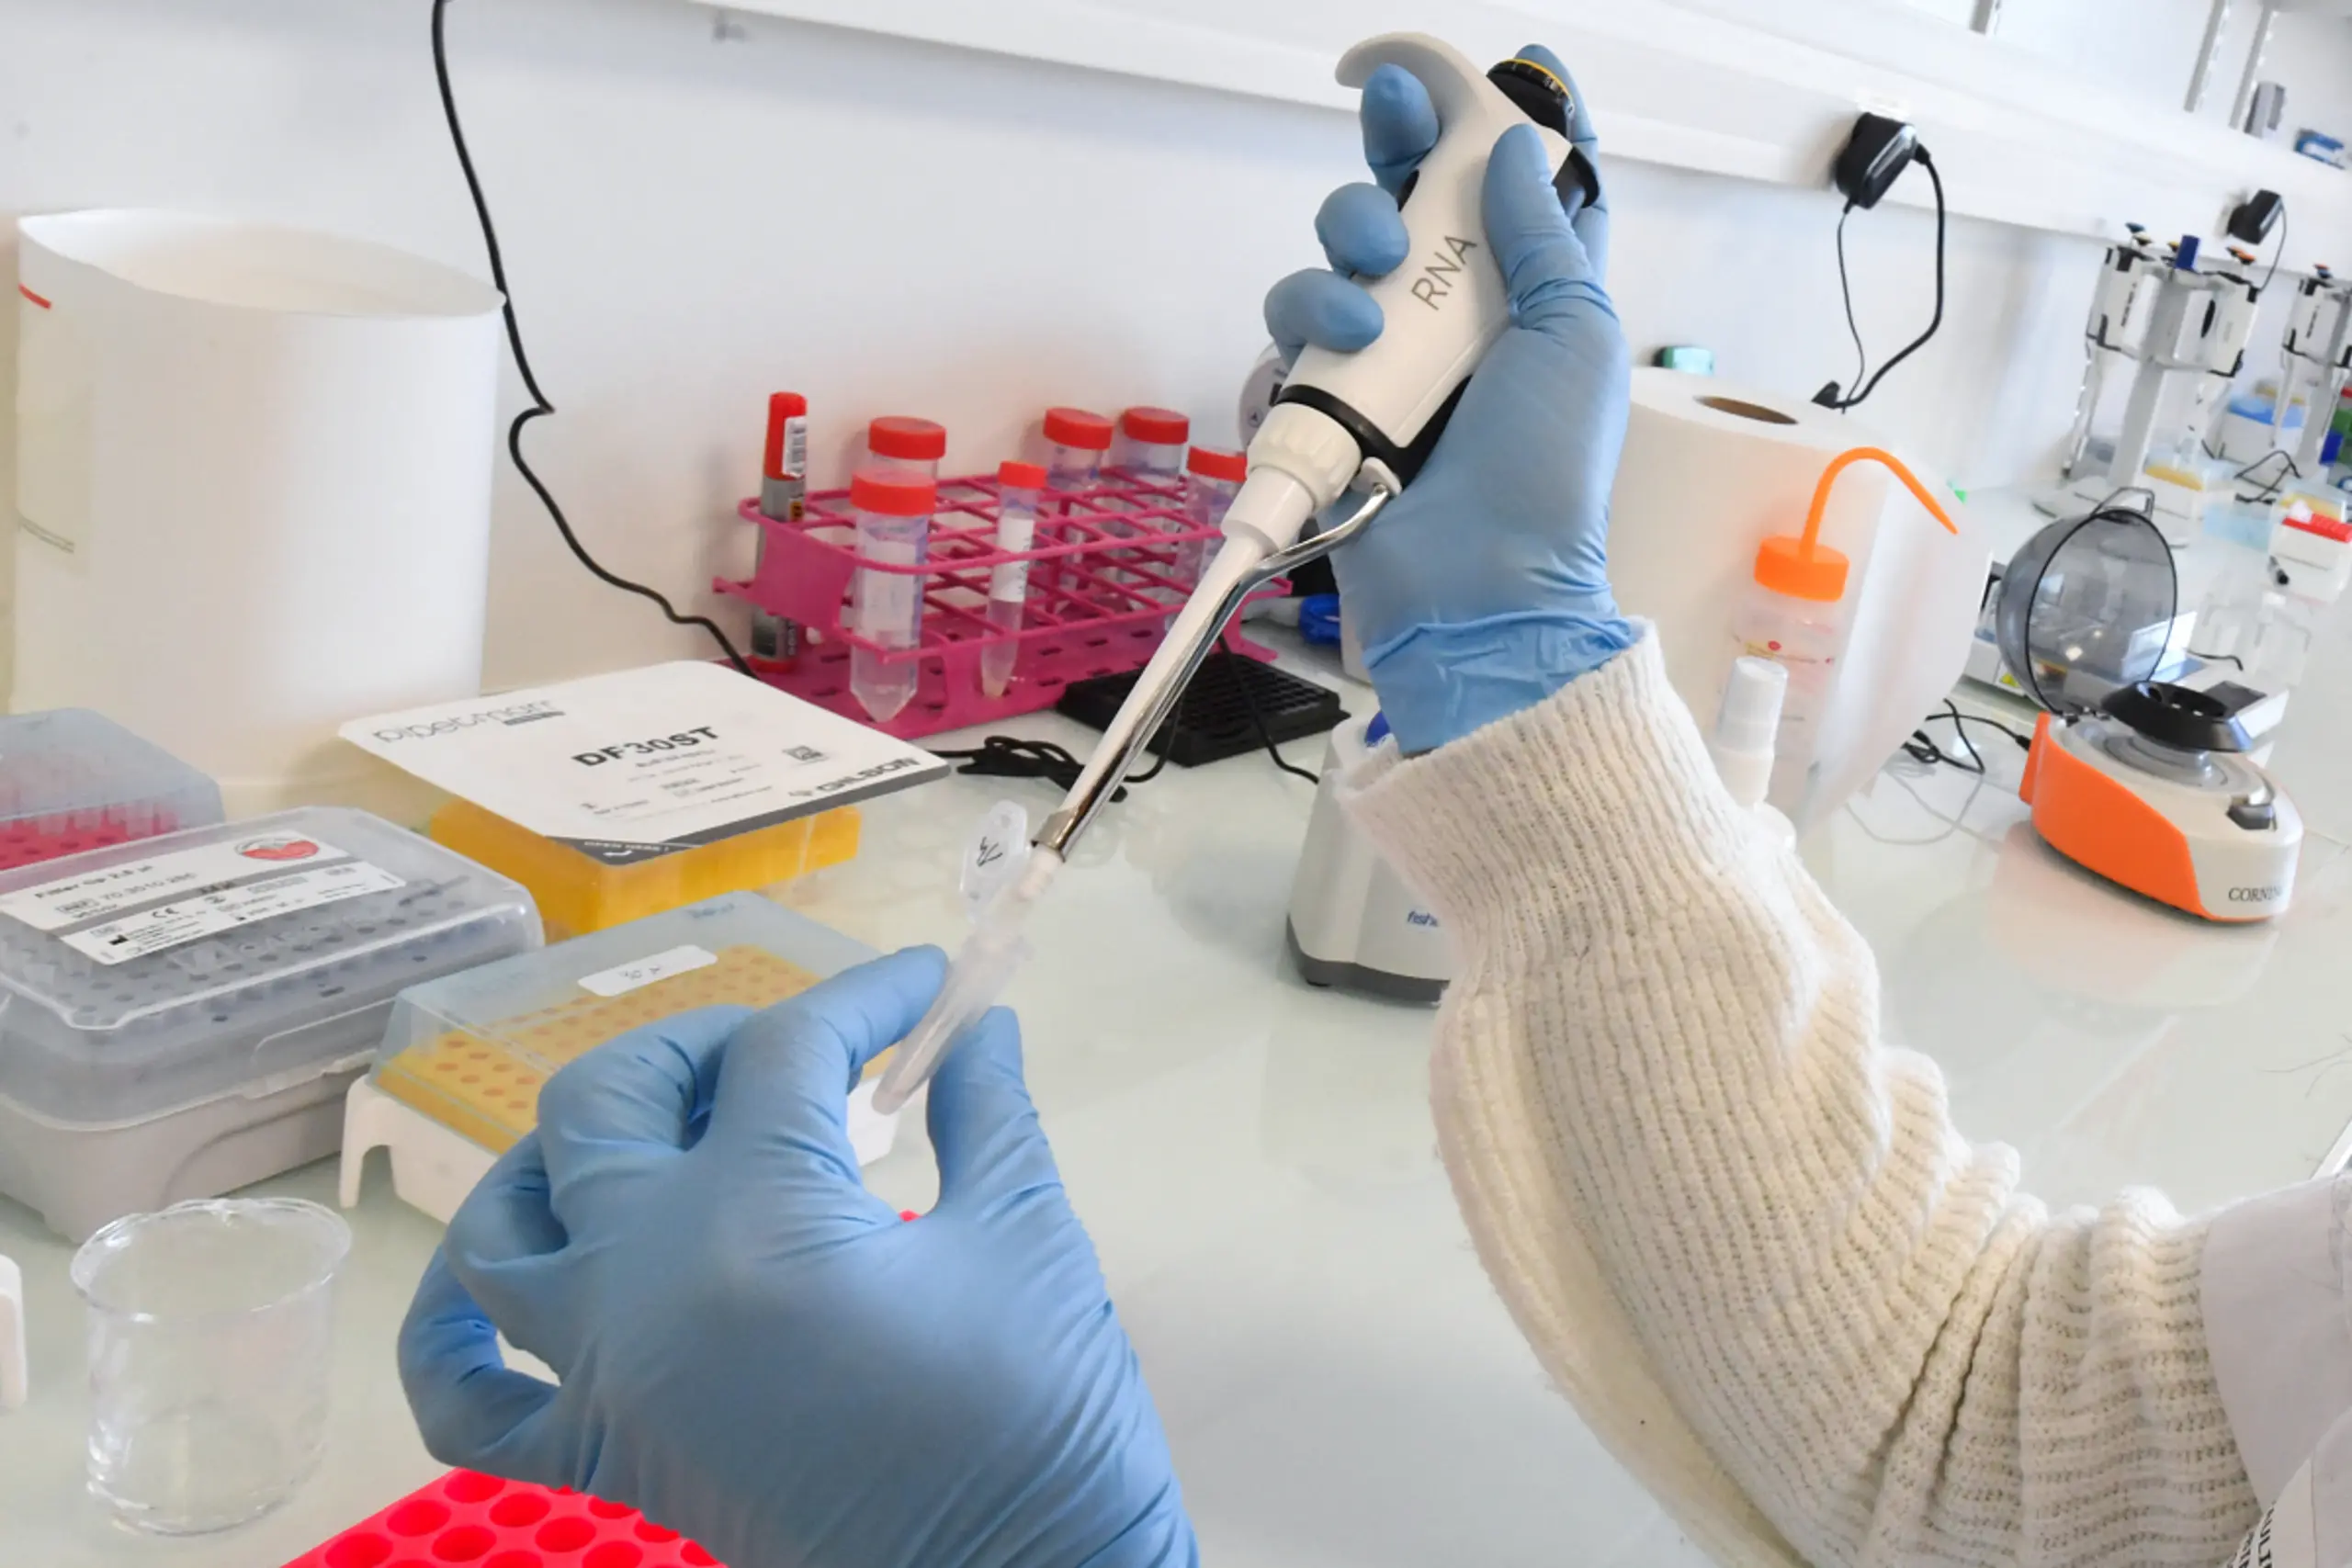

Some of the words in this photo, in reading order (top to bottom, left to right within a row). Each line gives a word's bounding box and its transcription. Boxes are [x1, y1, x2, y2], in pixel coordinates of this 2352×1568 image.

[1410, 235, 1477, 311] RNA
[571, 726, 718, 767] DF30ST
[2228, 886, 2283, 902] CORNIN
